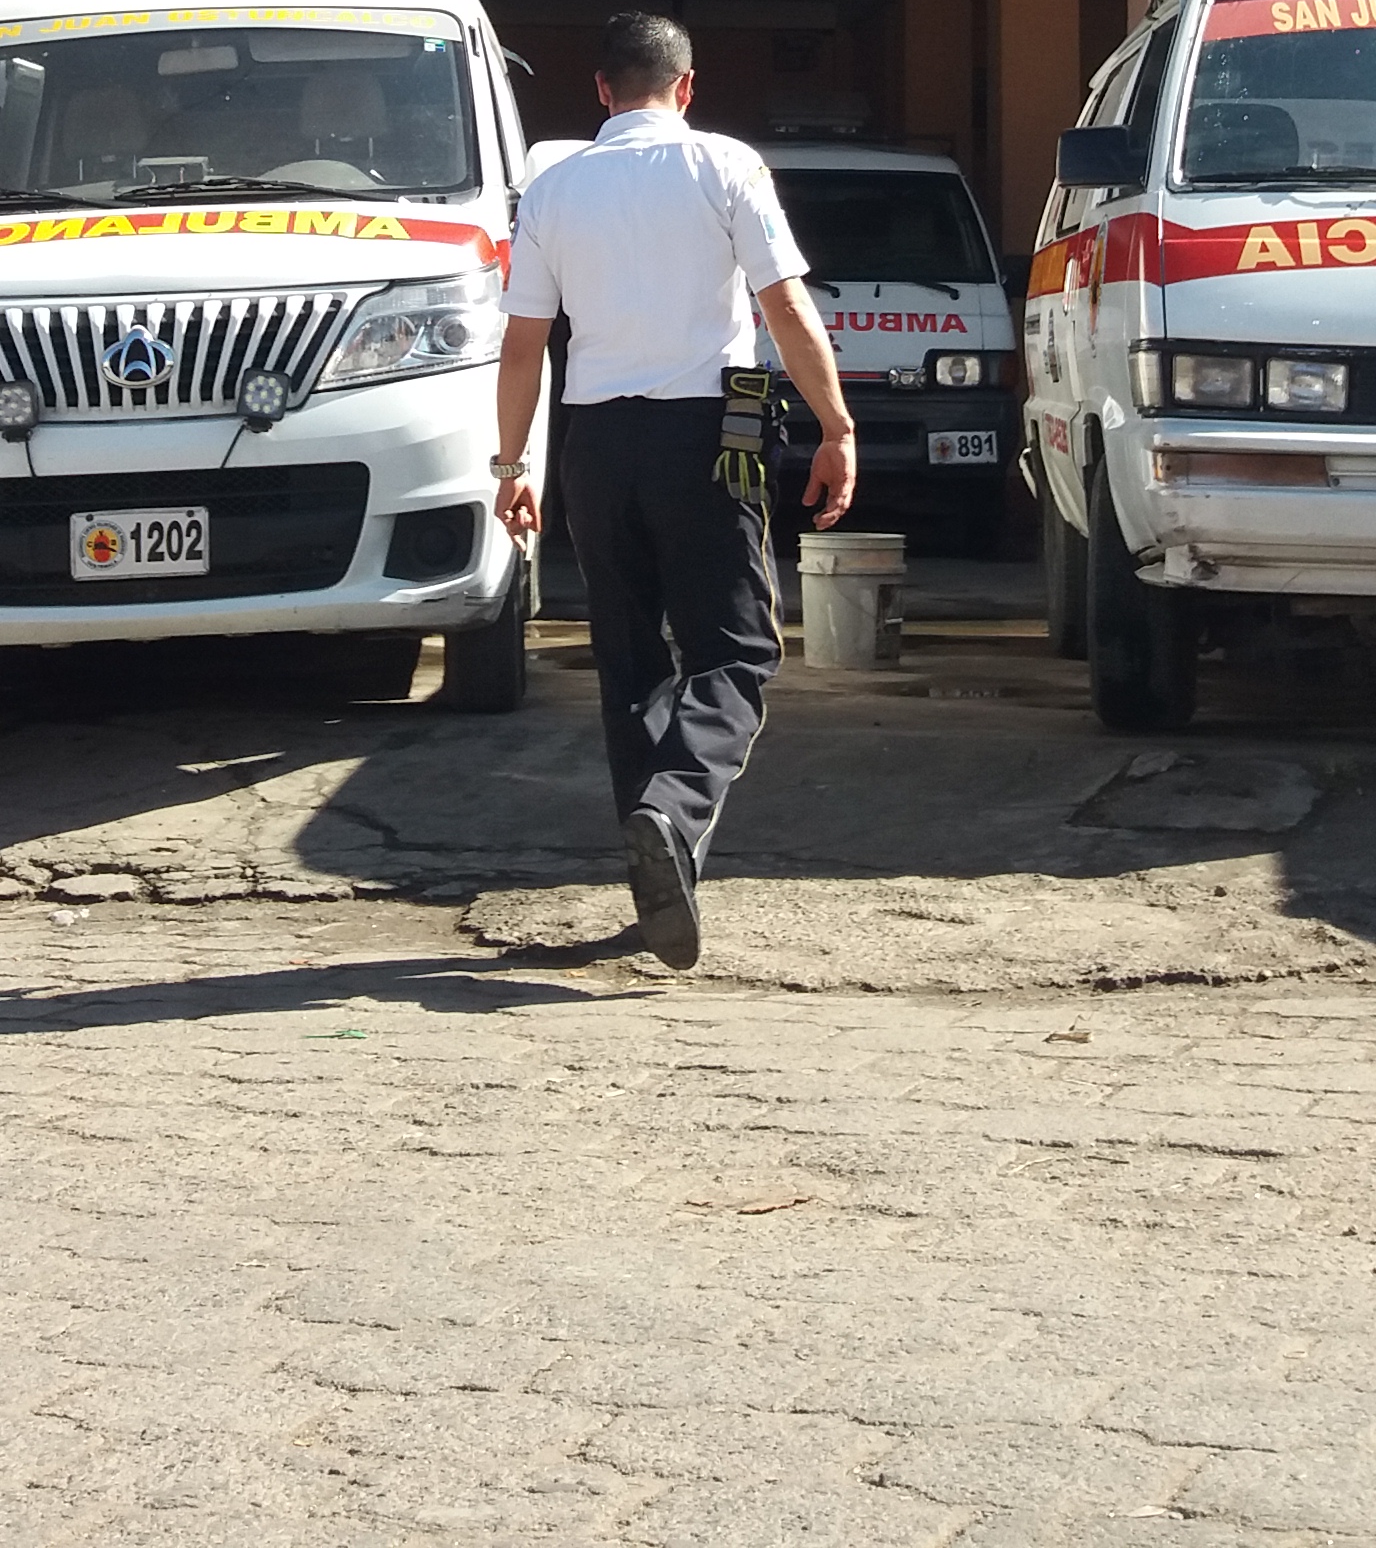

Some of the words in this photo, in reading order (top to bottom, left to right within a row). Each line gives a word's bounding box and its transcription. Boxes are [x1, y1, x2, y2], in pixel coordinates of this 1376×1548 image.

[39, 12, 151, 33] JUAN
[957, 435, 994, 457] 891
[130, 519, 203, 562] 1202
